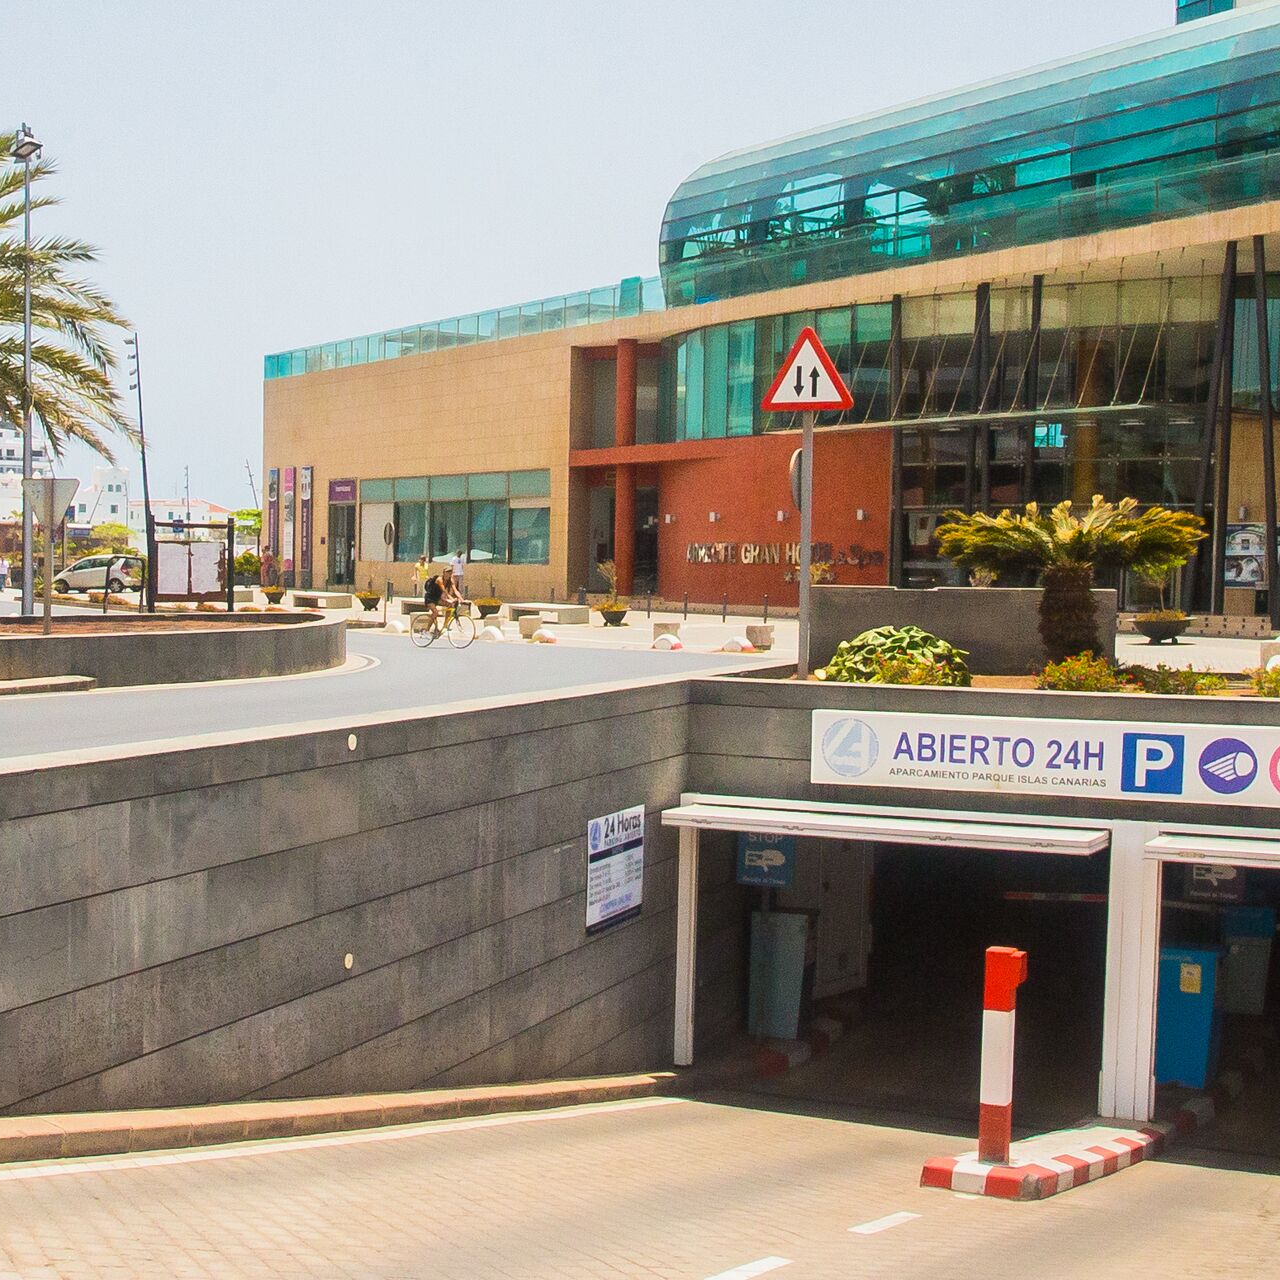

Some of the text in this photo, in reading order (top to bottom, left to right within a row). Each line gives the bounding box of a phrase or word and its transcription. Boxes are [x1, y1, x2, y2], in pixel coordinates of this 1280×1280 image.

[741, 543, 780, 564] GRAN
[892, 731, 1105, 772] ABIERTO 24H
[1134, 738, 1175, 787] P
[888, 767, 1107, 788] APARCAMIENTO PARQUE ISLAS CANARIAS
[604, 813, 641, 839] 24 Horas
